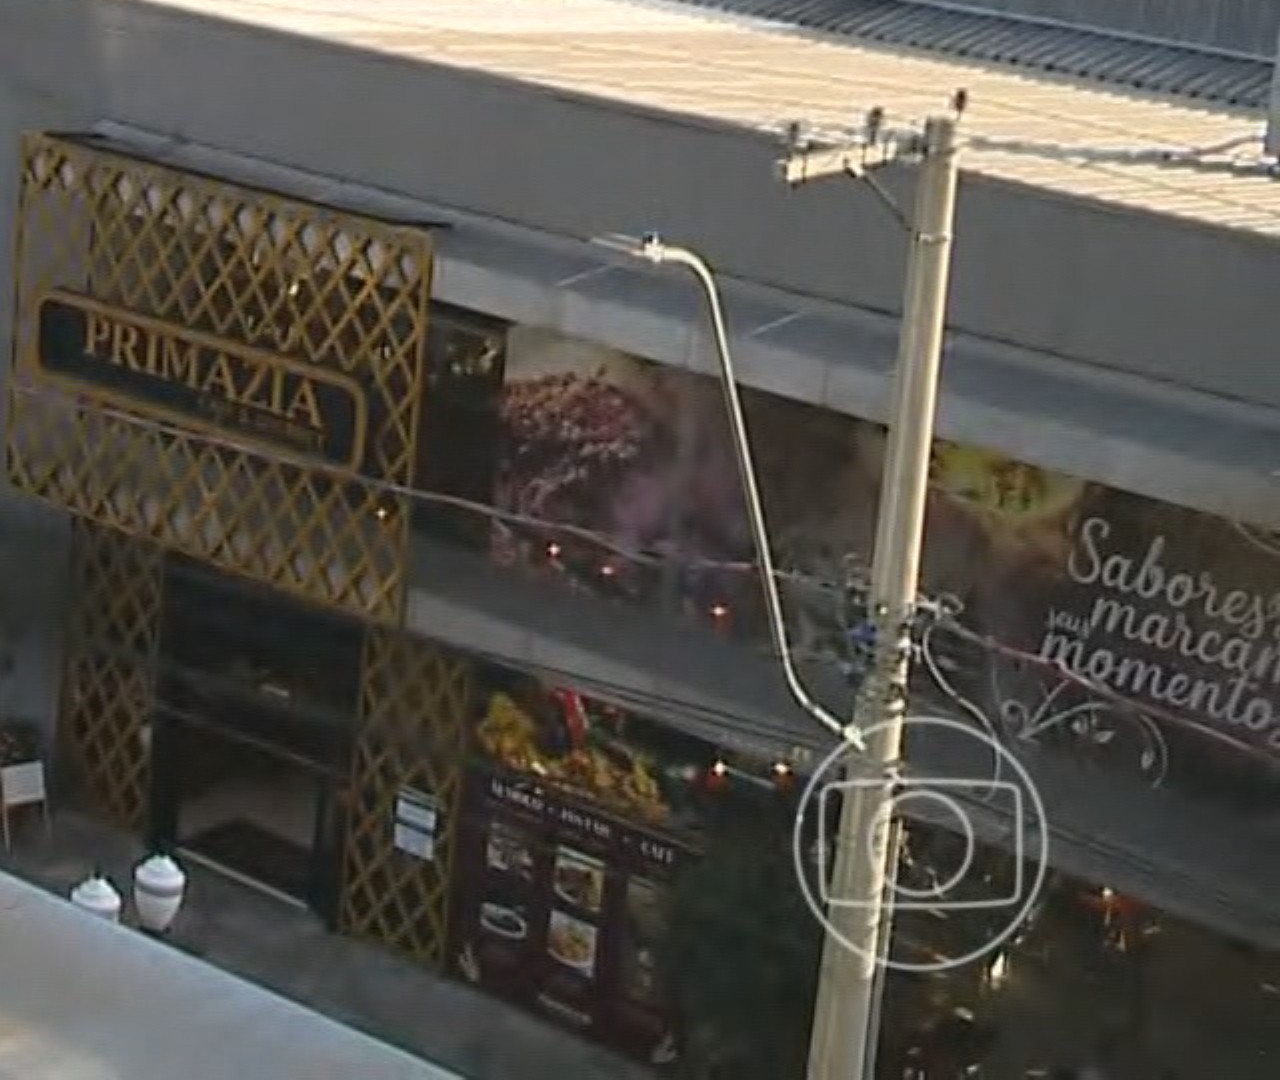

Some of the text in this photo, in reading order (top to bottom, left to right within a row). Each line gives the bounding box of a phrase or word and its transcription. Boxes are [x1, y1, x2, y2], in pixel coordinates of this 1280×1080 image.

[84, 311, 322, 429] PRIMAZIA
[1068, 518, 1264, 638] Sabores
[1040, 632, 1280, 748] momento
